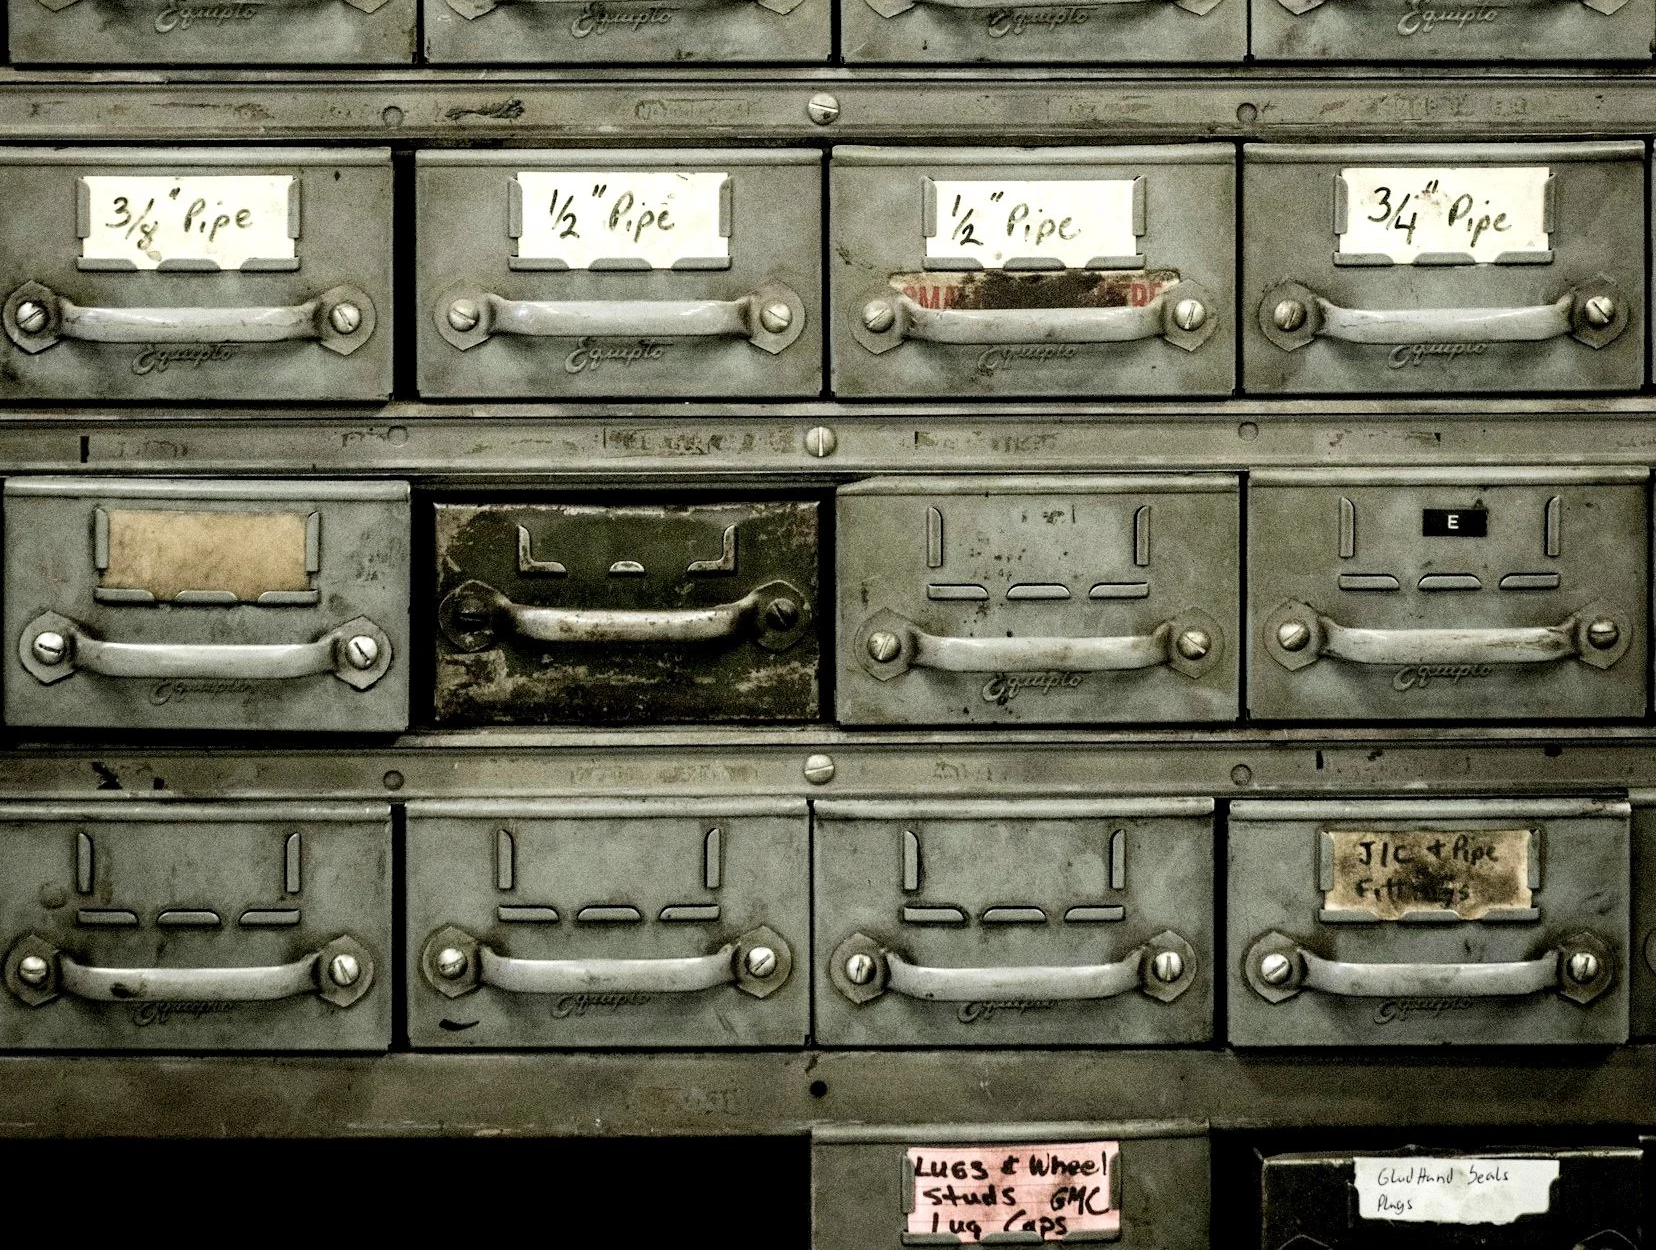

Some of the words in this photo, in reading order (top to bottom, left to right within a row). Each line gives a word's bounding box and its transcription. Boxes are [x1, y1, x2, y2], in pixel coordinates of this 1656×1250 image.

[183, 197, 253, 243] Pipe
[608, 190, 675, 243] Pipe
[1006, 203, 1081, 246] Pipe
[1448, 193, 1513, 248] Pipe
[1448, 514, 1459, 529] E
[1029, 1151, 1107, 1177] Wheel
[1467, 1165, 1509, 1186] Seals
[1050, 1186, 1109, 1215] GMC
